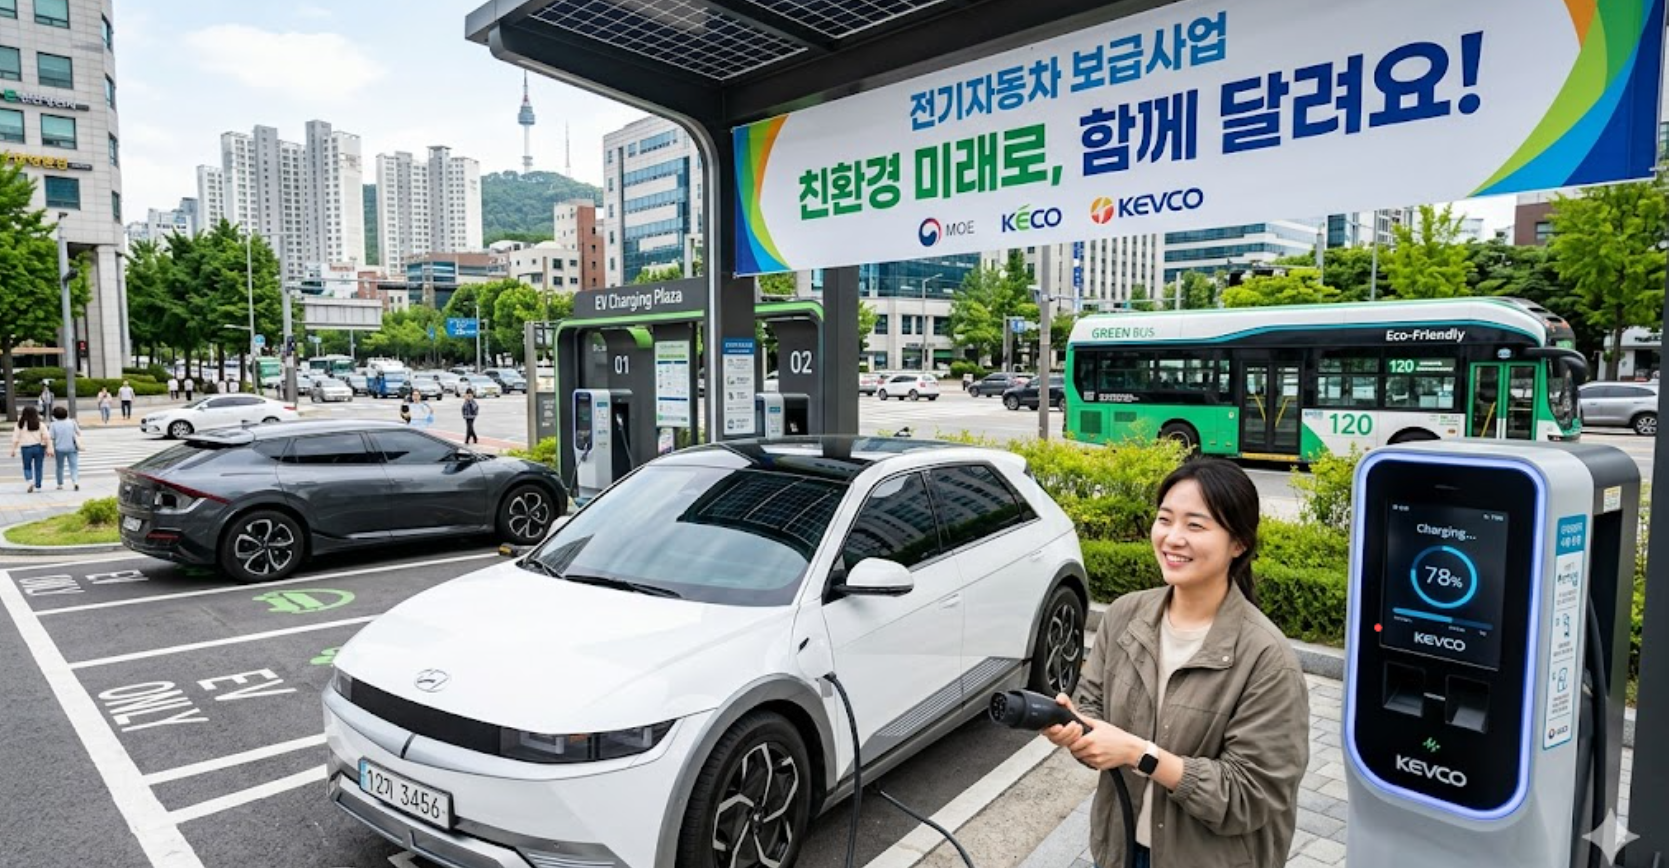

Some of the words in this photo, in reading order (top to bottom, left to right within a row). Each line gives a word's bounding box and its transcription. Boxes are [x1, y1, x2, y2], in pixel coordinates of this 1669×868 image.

[910, 56, 1062, 131] 전기자동차
[1070, 11, 1227, 93] 보급사업
[799, 152, 901, 220] 친환경
[915, 123, 1063, 200] 미래로,
[1079, 89, 1199, 177] 함께
[1220, 30, 1484, 154] 달려요!
[1118, 187, 1204, 218] KEVCO
[946, 220, 975, 237] MOE
[595, 294, 607, 310] EV
[608, 291, 652, 312] Charging
[654, 287, 683, 305] Plaza
[1092, 327, 1131, 339] GREEN
[1133, 327, 1155, 338] BUS
[1386, 328, 1466, 343] Eco-Friendly
[615, 355, 629, 374] 01
[790, 350, 812, 374] 02
[1389, 359, 1414, 373] 120
[1329, 413, 1373, 436] 120
[1425, 565, 1463, 588] 78%
[1414, 631, 1466, 651] KEVCO
[196, 668, 297, 701] EV
[98, 681, 210, 732] ONLY
[1396, 754, 1467, 787] KEVCO
[400, 784, 440, 819] 3456
